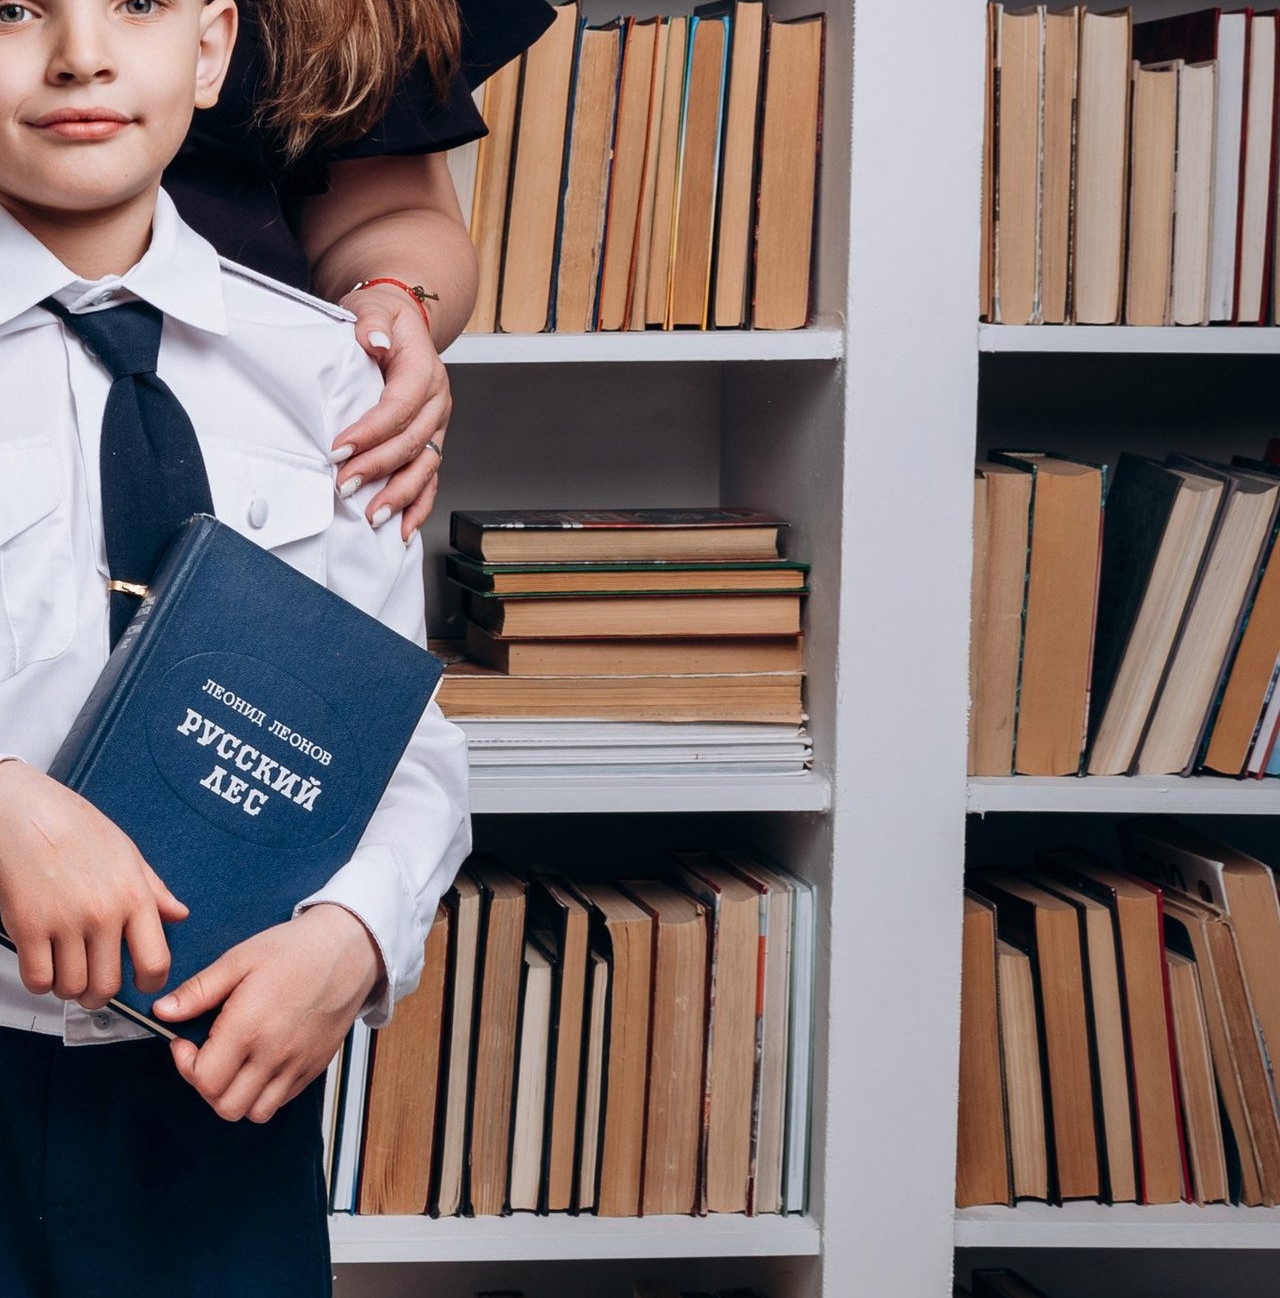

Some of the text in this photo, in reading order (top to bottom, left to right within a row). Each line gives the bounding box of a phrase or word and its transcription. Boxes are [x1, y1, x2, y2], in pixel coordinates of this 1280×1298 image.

[176, 707, 322, 812] РУССКИЙ
[201, 678, 333, 766] ЛЕОНИД ЛЕОНОВ
[199, 764, 270, 816] ЛЕС
